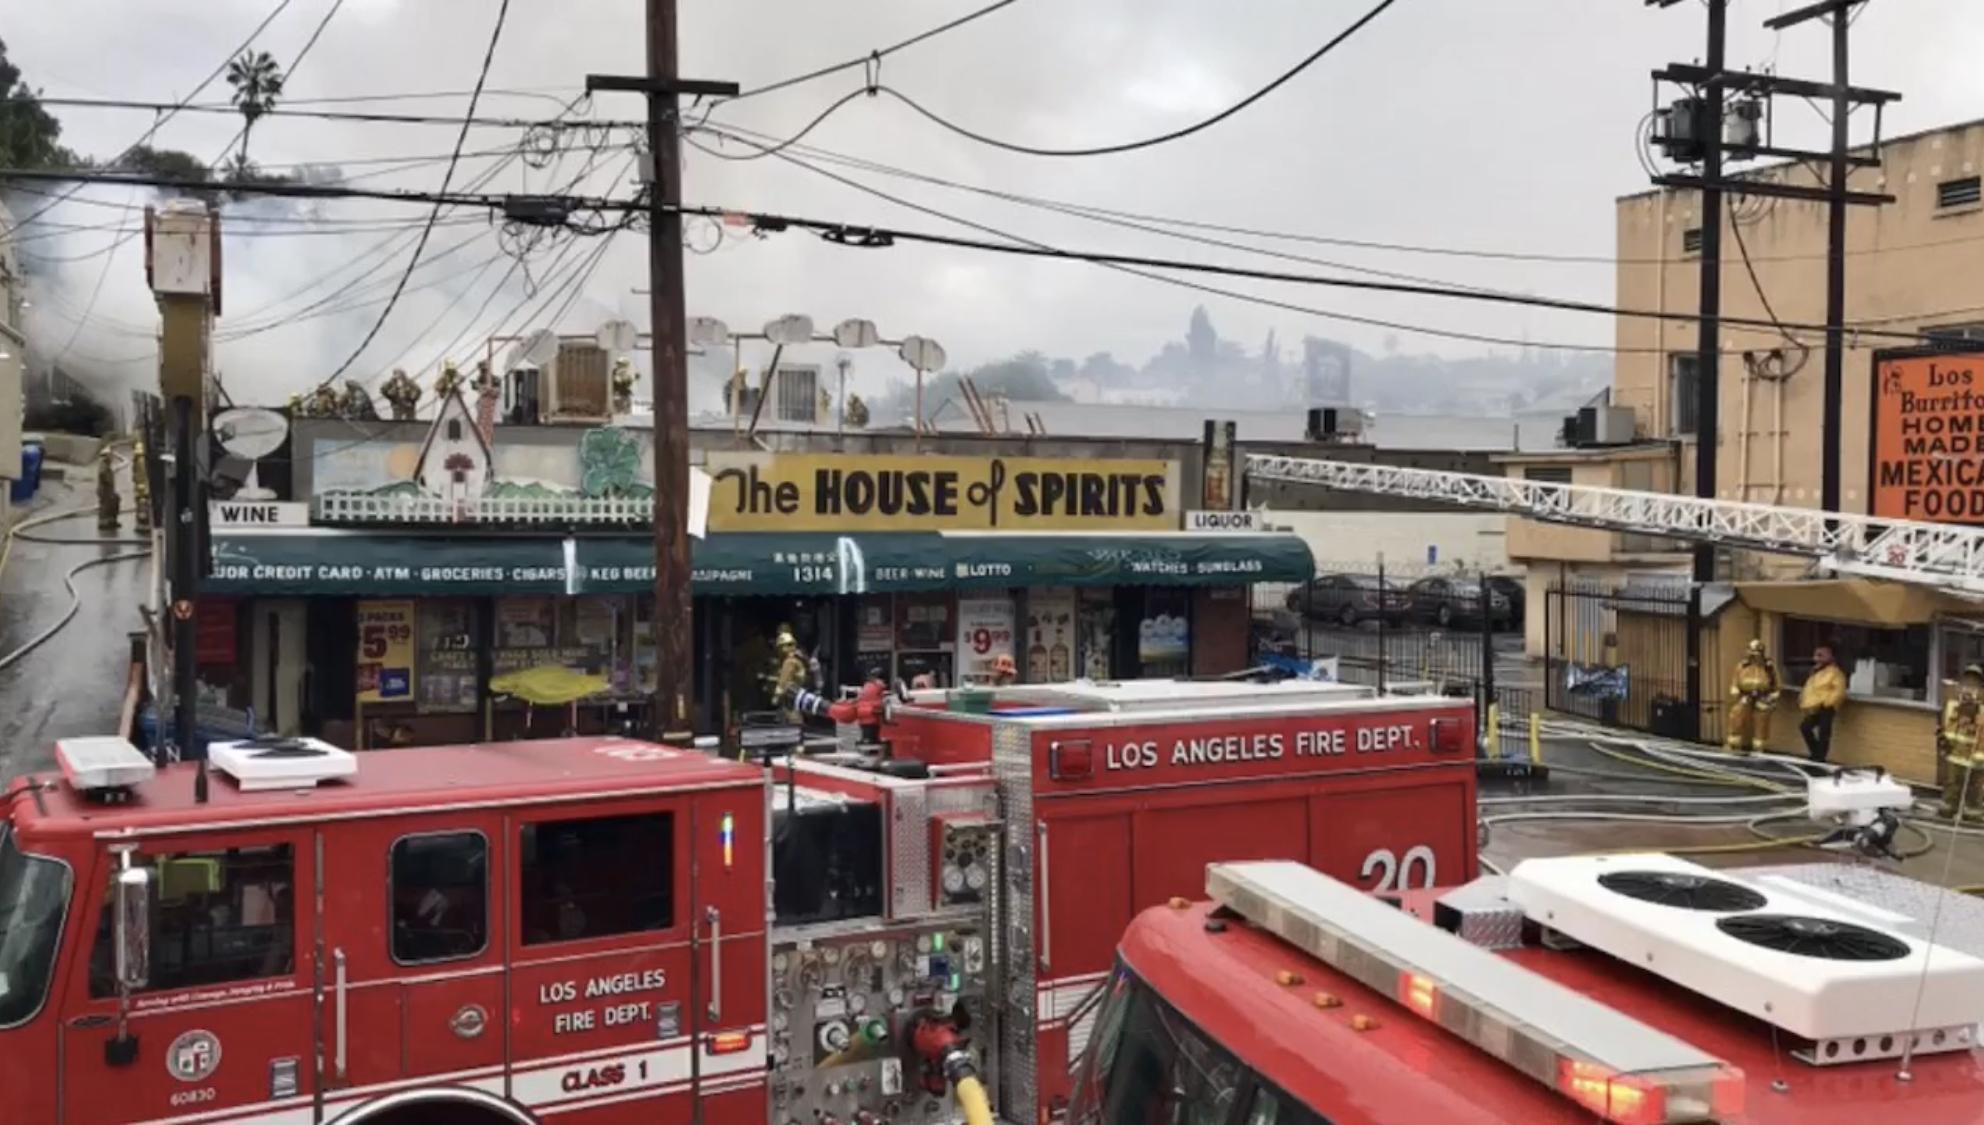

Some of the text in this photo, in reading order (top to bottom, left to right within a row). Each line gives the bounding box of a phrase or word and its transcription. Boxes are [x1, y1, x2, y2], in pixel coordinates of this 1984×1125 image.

[1928, 363, 1973, 387] Los
[714, 459, 1166, 526] The HOUSE of SPIRITS
[1904, 489, 1984, 517] FOOD
[221, 505, 279, 522] WINE
[1194, 513, 1253, 529] LIQUOR
[253, 565, 313, 579] CREDIT
[318, 566, 363, 579] CARD
[373, 567, 410, 580] ATM
[421, 567, 504, 580] GROCERIES
[513, 567, 566, 580] CIGARS
[591, 567, 620, 580] KEG
[794, 566, 833, 582] 1314
[875, 567, 946, 580] BEER WINE
[969, 563, 1012, 576] LOTTO
[1106, 725, 1420, 769] LOS ANGELES FIRE DEPT.
[1361, 845, 1436, 892] 20
[540, 969, 666, 1004] LOS ANGELES
[554, 1009, 595, 1033] FIRE
[604, 1002, 652, 1026] DEPT.
[561, 1059, 647, 1092] CLASS 1
